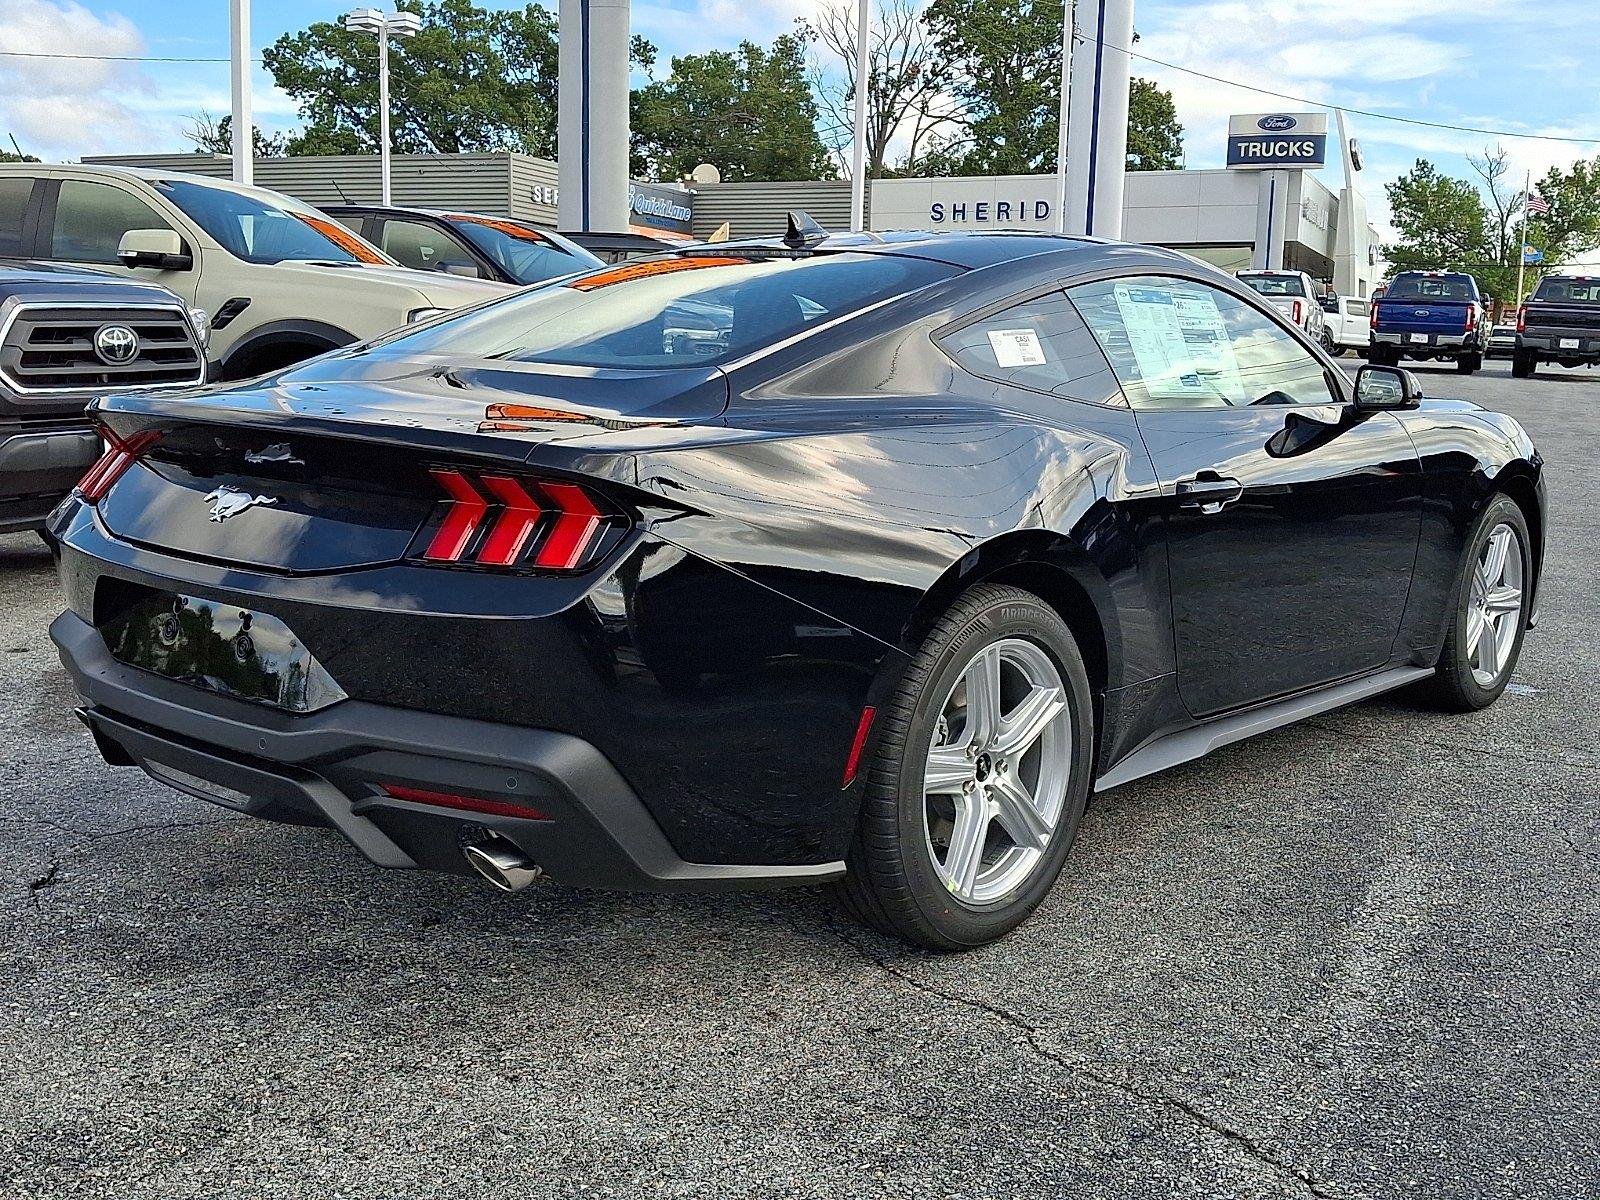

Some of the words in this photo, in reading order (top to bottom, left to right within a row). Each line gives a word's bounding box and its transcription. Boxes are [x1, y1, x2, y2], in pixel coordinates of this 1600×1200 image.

[1265, 117, 1289, 128] Ford
[1237, 141, 1315, 158] TRUCKS
[930, 200, 1051, 222] SHERID
